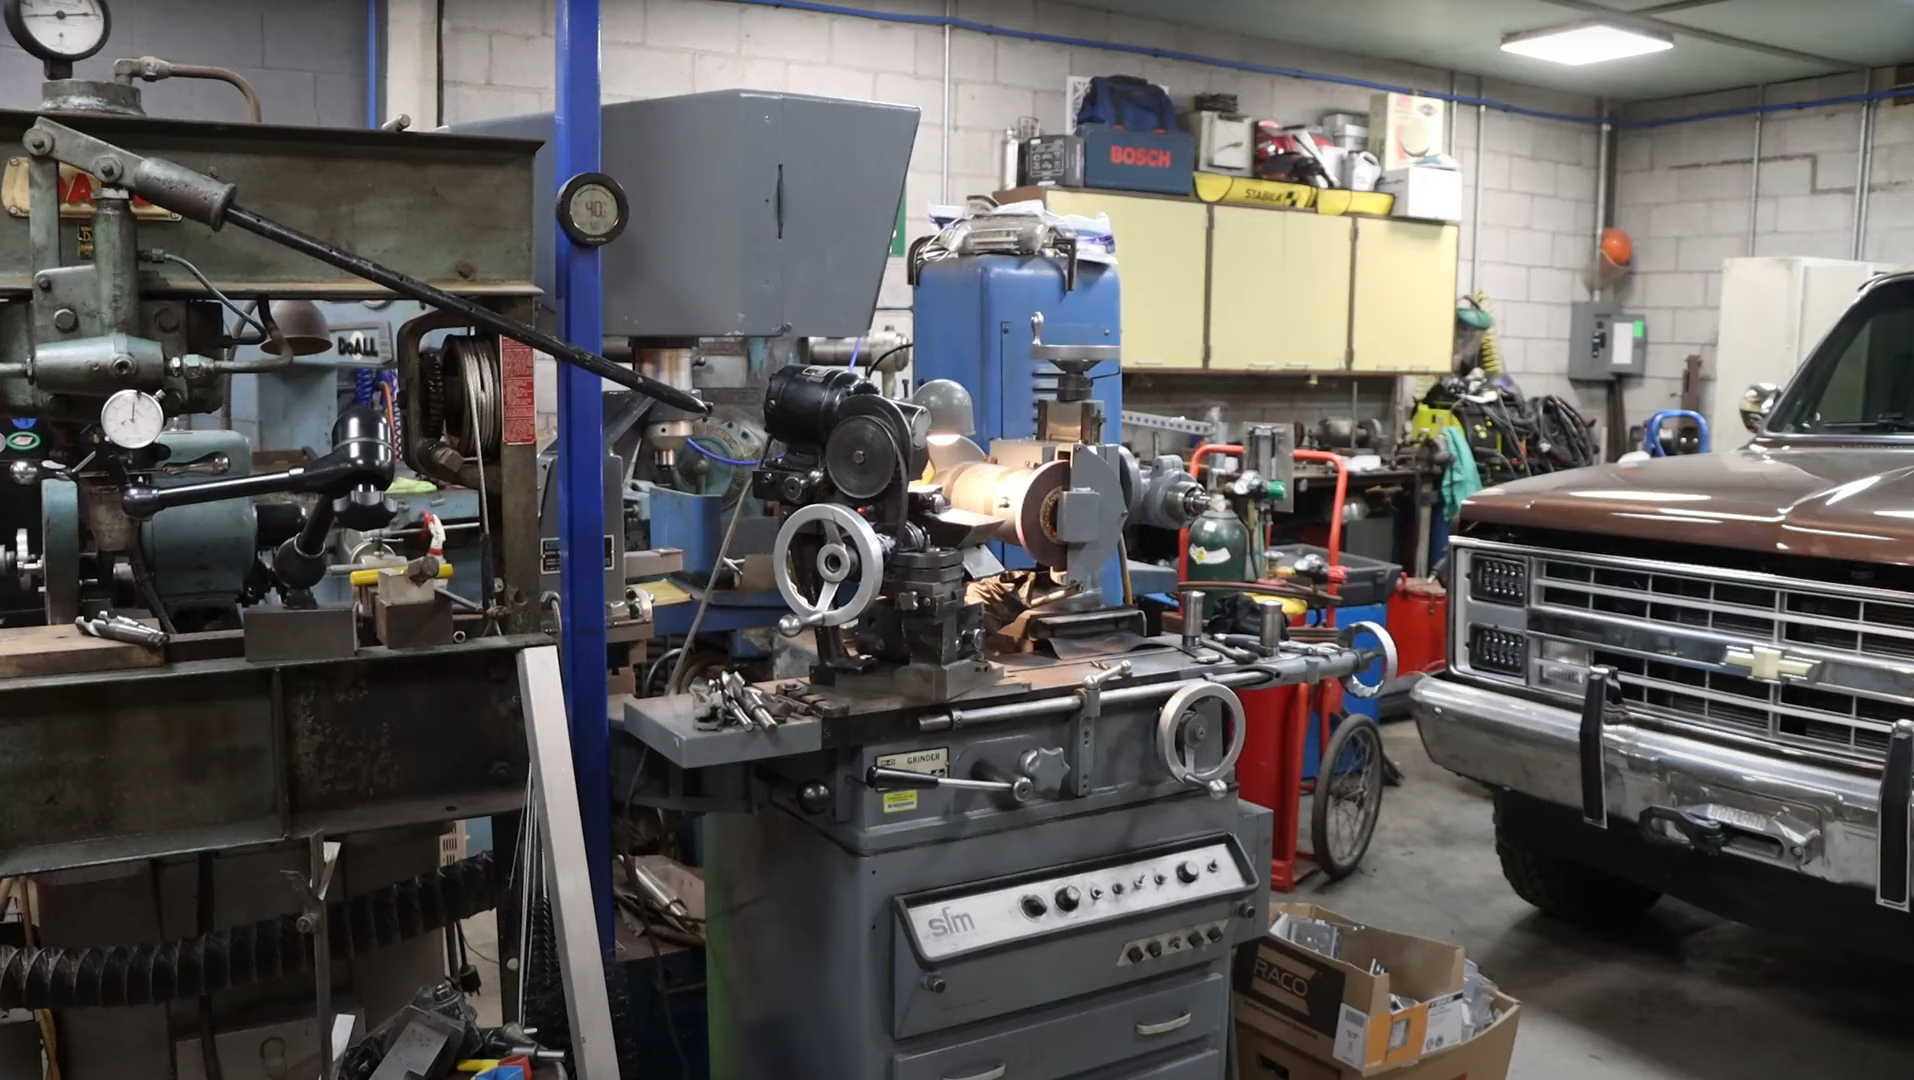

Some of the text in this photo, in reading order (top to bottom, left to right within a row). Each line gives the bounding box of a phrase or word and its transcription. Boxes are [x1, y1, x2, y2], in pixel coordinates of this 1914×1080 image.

[1111, 145, 1171, 169] BOSCH
[1245, 187, 1283, 202] STABILA
[337, 336, 379, 356] DoALL
[906, 753, 941, 765] GRINDER
[928, 906, 976, 937] sfm
[1254, 959, 1309, 997] RACO
